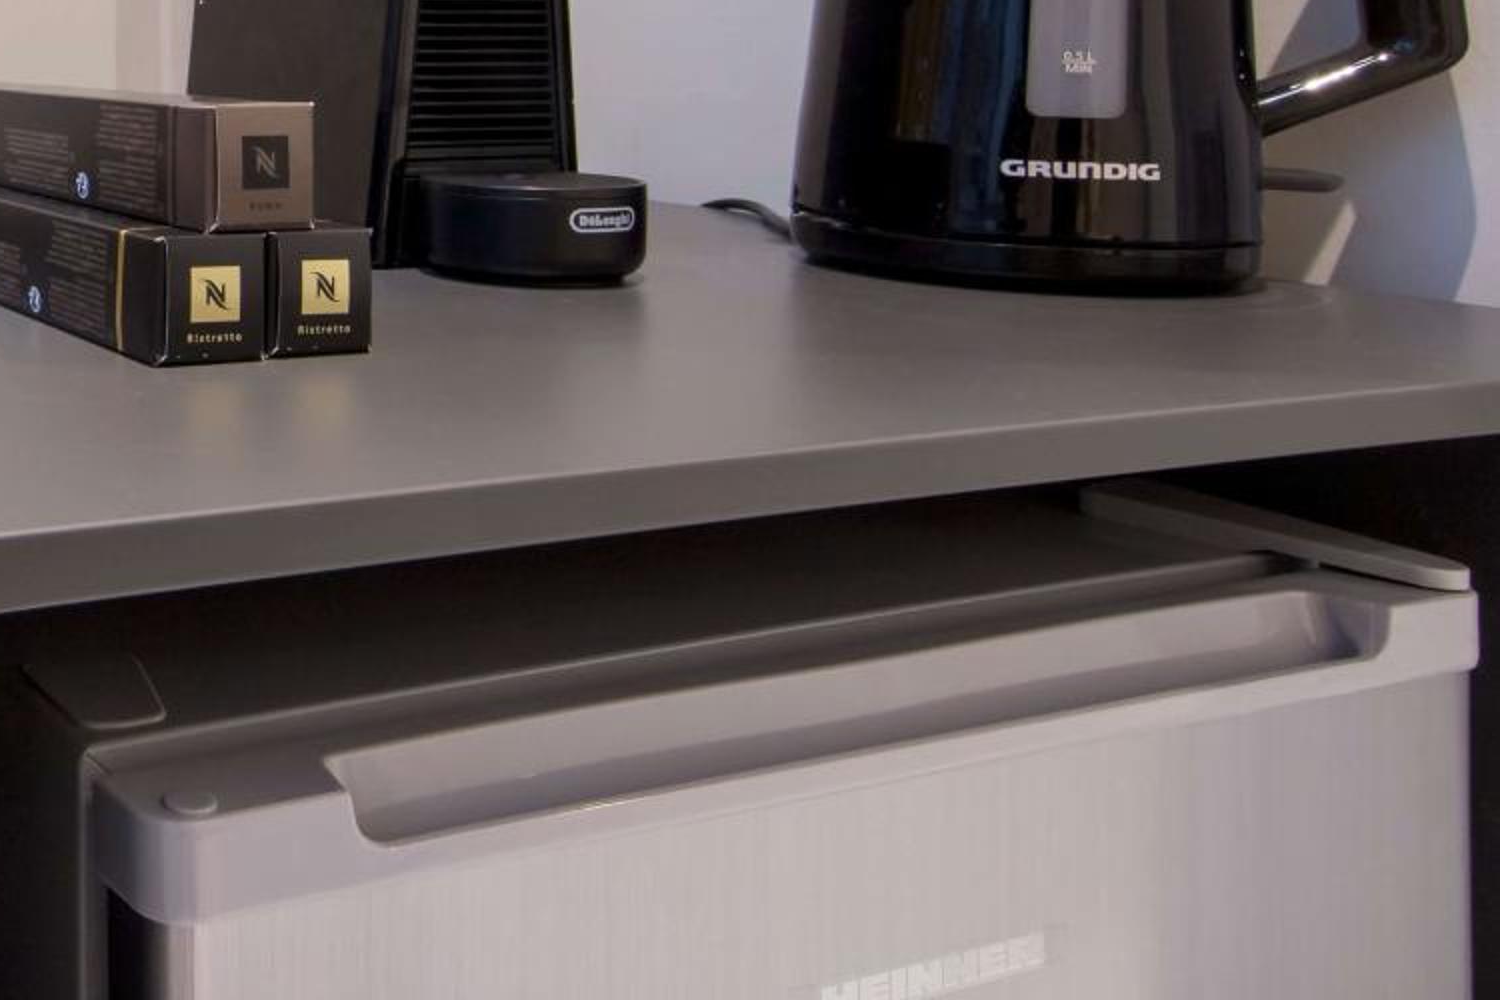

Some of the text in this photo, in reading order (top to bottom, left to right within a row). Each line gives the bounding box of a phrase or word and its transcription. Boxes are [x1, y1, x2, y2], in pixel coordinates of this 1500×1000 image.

[1000, 158, 1161, 181] GRUNDIG
[297, 324, 351, 336] Ristretto
[186, 332, 243, 344] Ristretto
